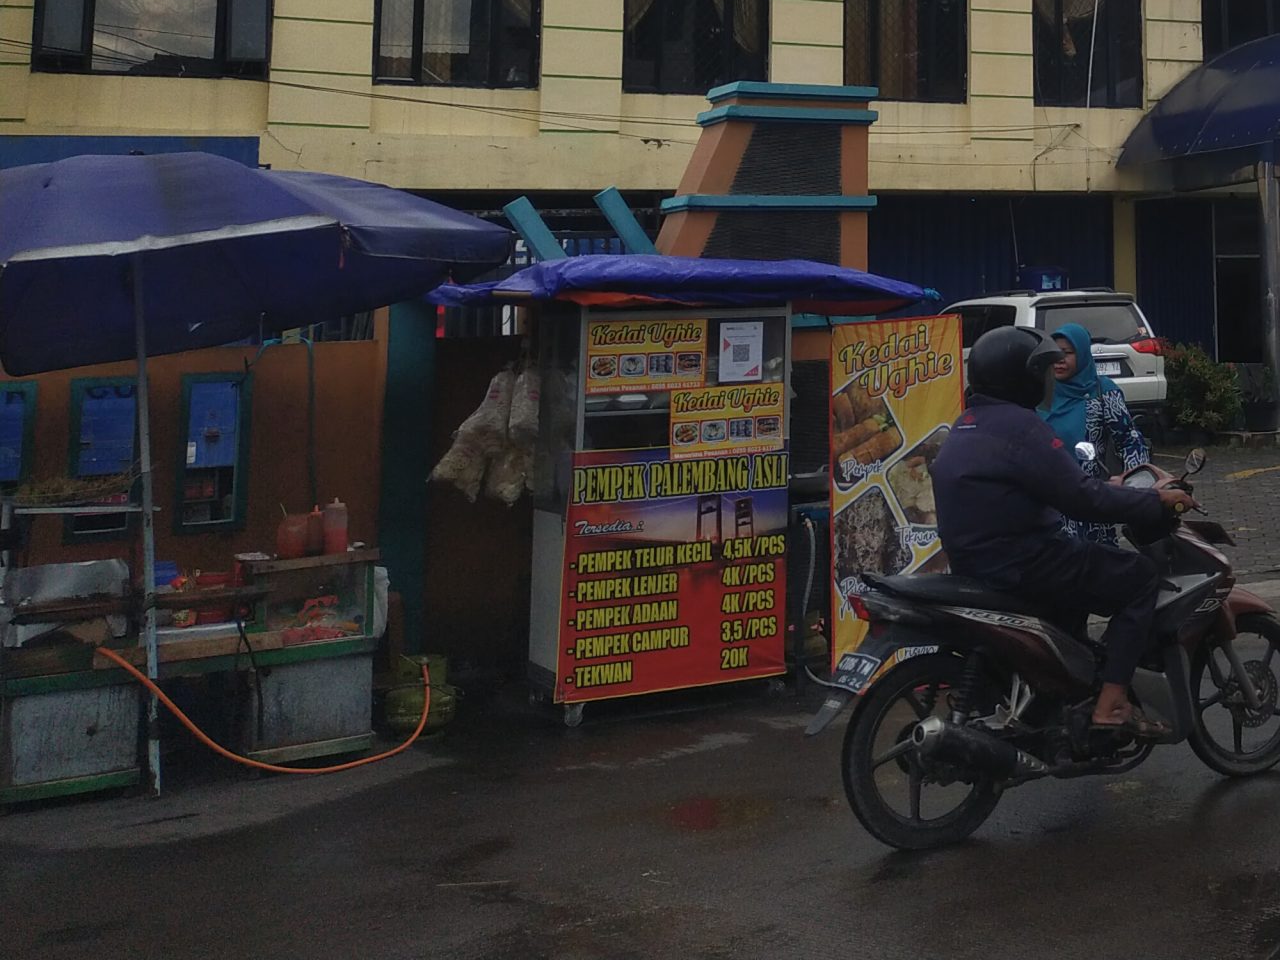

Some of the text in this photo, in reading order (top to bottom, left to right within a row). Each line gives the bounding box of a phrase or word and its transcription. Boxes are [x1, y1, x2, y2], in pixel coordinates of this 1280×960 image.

[592, 322, 702, 348] Kedai Ughie
[839, 324, 929, 374] Kedai
[859, 352, 953, 398] Ughie
[674, 387, 780, 413] Kedai Ughie
[572, 453, 788, 503] PEMPEK PALEMBANG ASLI
[575, 520, 632, 535] Tersedia
[578, 549, 632, 574] PEMPEK
[635, 544, 674, 567] TELUR
[677, 541, 713, 564] KECIL
[577, 562, 775, 601] PEMPEK LENJER 4K /PCS
[576, 590, 774, 630] PEMPEK ADAAN 4K /PCS
[575, 616, 777, 659] PEMPEK CAMPUR 3,5 /PCS
[575, 647, 748, 688] TEKWAN 20K
